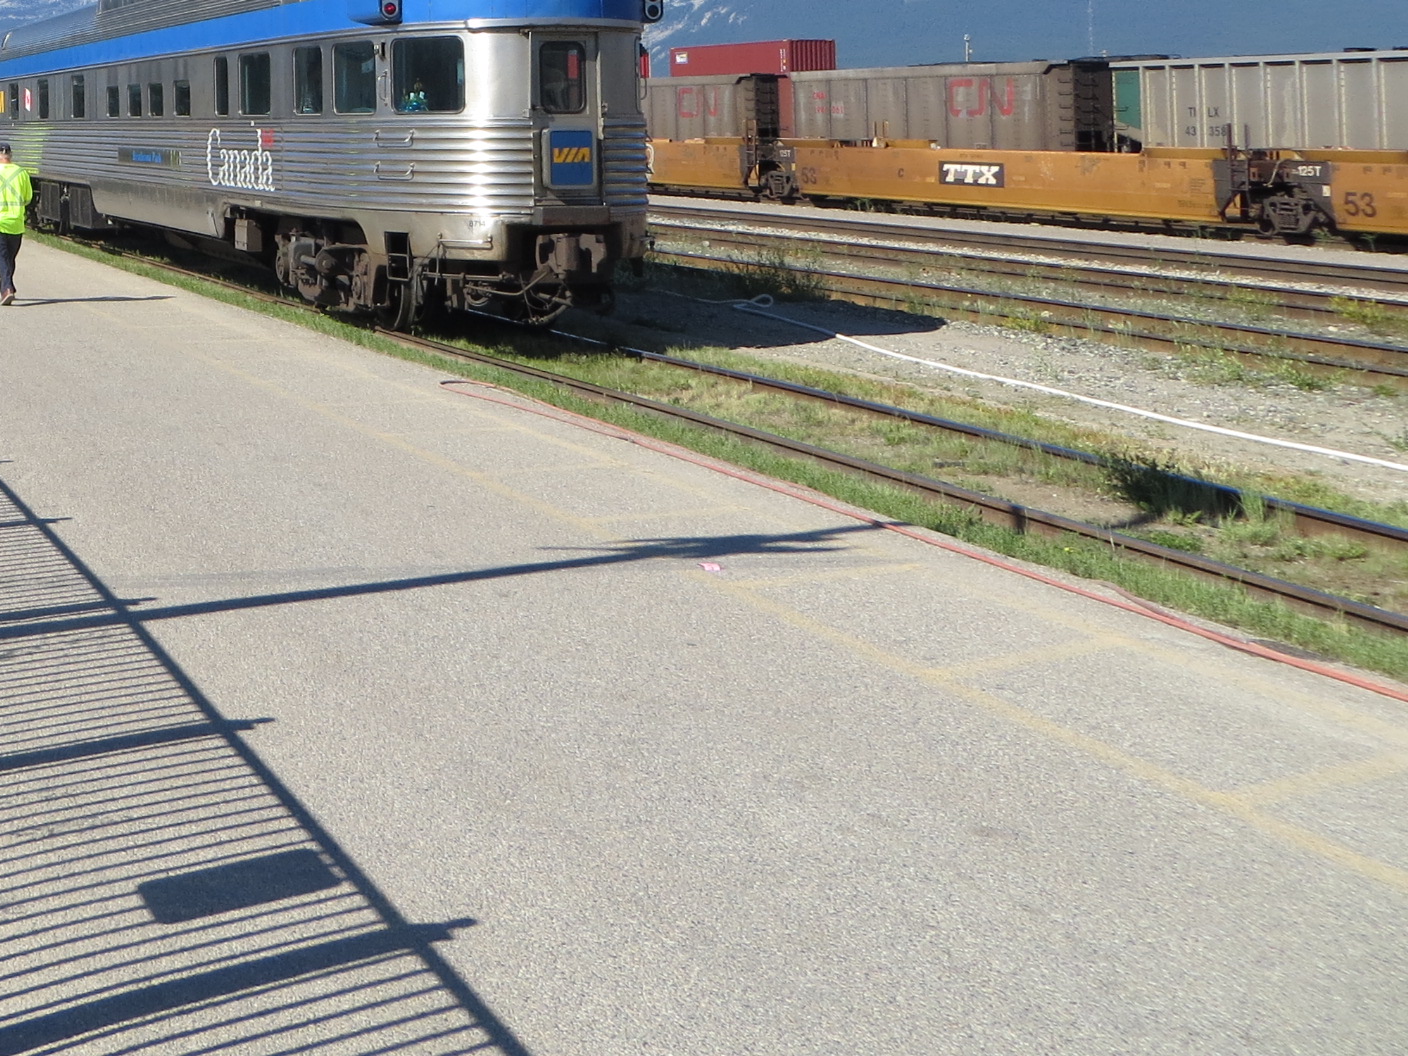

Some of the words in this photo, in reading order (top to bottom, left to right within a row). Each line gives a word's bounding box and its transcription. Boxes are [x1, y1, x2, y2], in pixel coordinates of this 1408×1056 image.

[948, 76, 1015, 117] CN
[206, 128, 275, 192] Canada
[553, 147, 591, 163] VIA
[801, 167, 817, 184] 53
[942, 163, 1000, 185] TTX
[1297, 165, 1321, 176] 125T
[1344, 192, 1377, 217] 53
